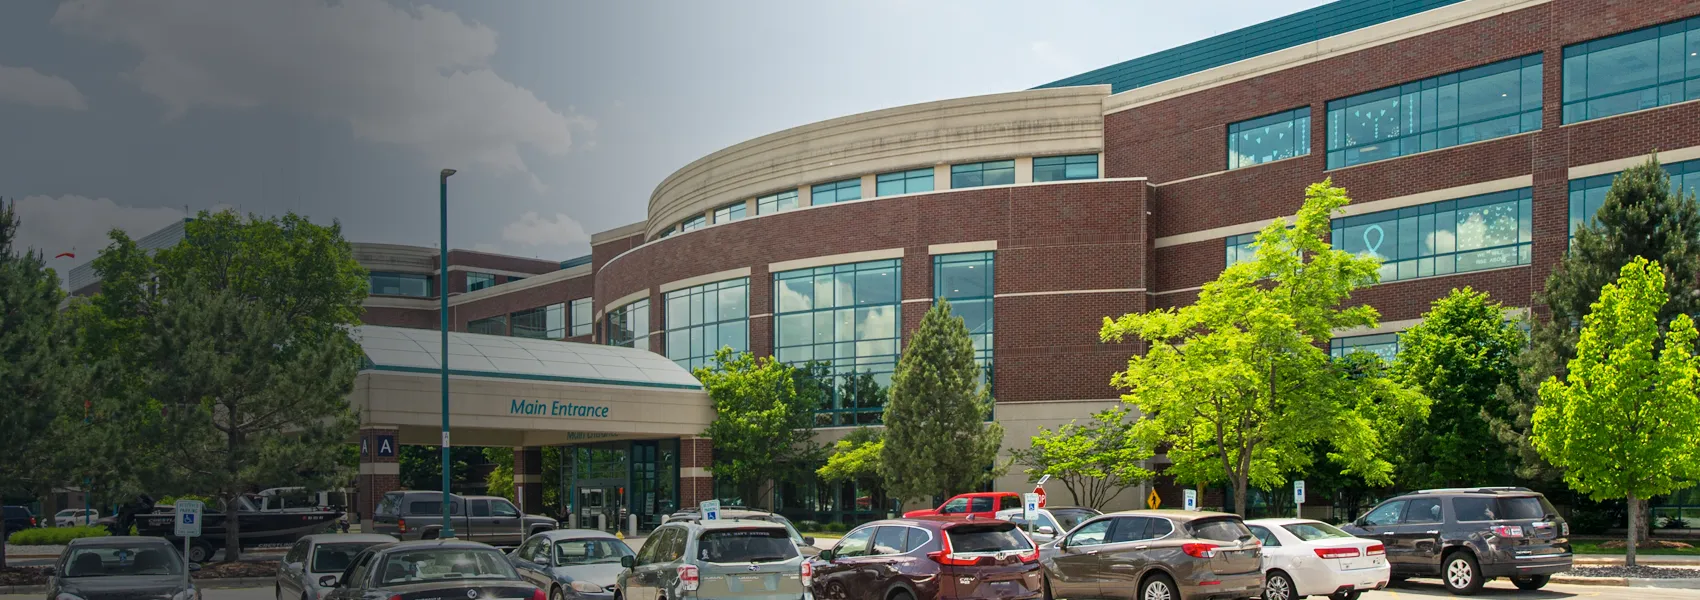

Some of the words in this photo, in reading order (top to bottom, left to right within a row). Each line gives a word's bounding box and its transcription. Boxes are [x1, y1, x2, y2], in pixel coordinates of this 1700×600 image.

[510, 399, 546, 415] Main
[552, 401, 609, 418] Entrance
[362, 439, 368, 453] A
[380, 439, 392, 453] A
